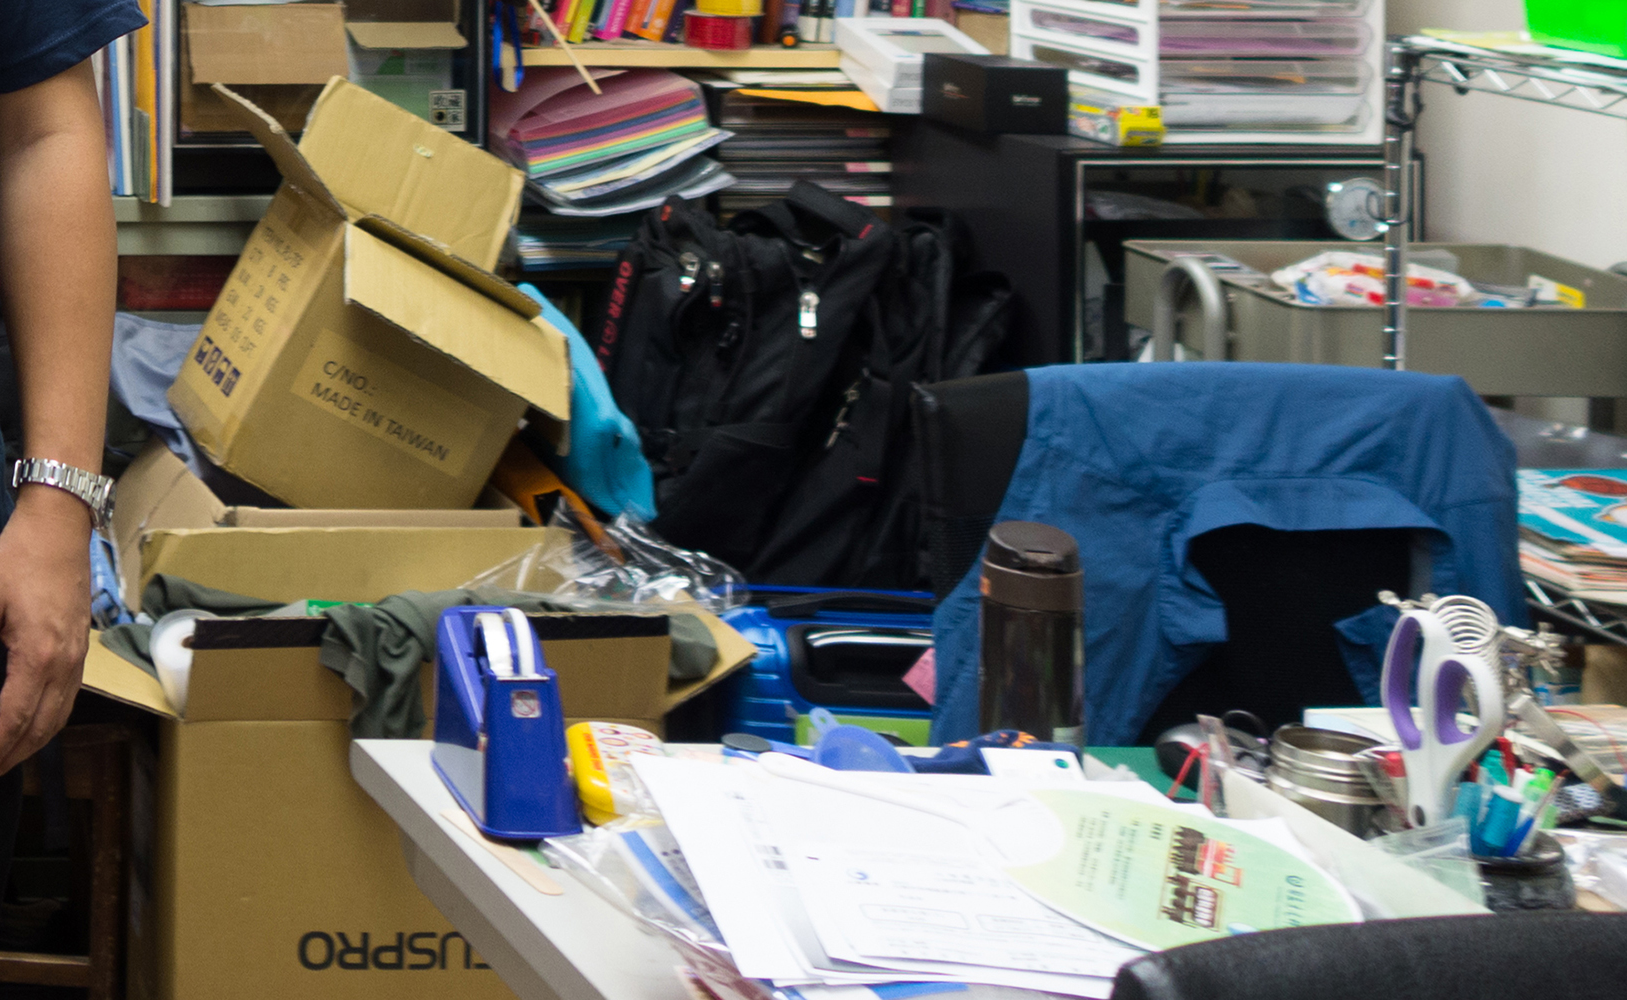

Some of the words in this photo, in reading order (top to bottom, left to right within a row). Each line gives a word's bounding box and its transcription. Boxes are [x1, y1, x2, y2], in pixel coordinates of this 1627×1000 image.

[311, 382, 363, 417] MADE
[363, 410, 386, 428] IN
[386, 419, 451, 462] TAIWAN
[298, 930, 493, 971] USPRO
